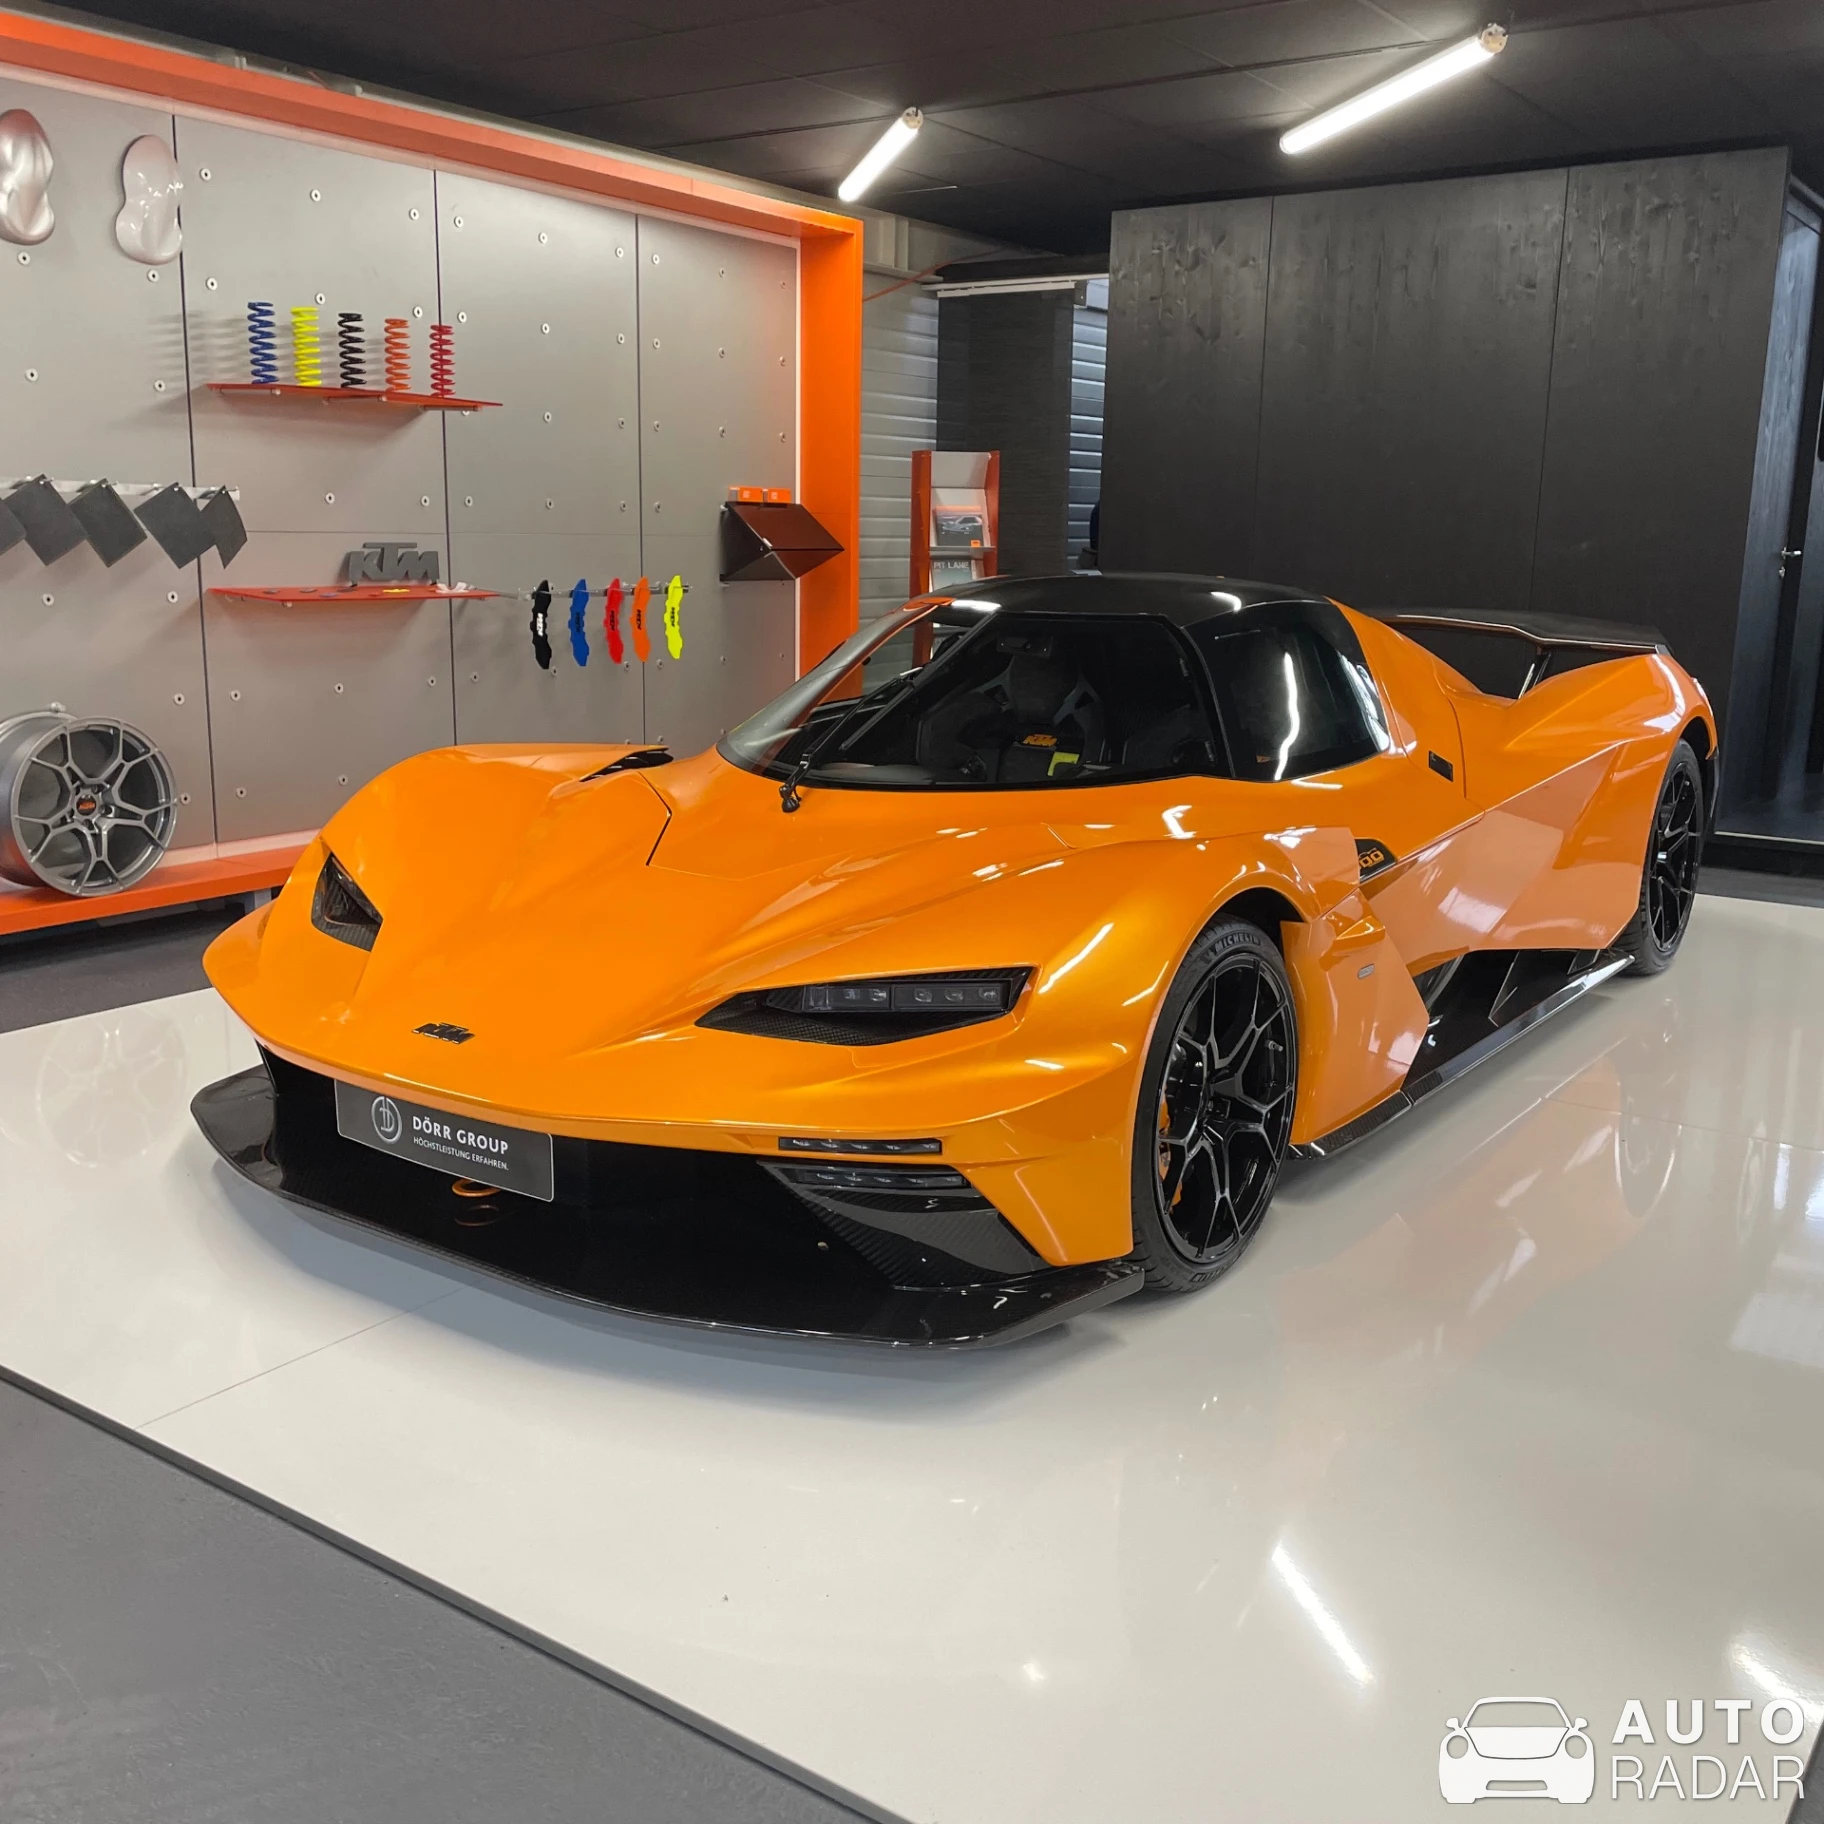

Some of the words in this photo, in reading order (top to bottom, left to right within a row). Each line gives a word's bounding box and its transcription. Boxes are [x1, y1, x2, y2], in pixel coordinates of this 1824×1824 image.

[345, 542, 439, 587] KTM
[933, 561, 945, 569] PIT
[948, 561, 969, 569] LANE
[1214, 932, 1260, 954] MICHELIN
[412, 1022, 475, 1045] KTM
[412, 1115, 452, 1141] DÖRR
[456, 1129, 509, 1155] GROUP
[413, 1136, 471, 1160] HÖCHSTLEISTUNG
[471, 1153, 509, 1171] ERFAHREN.
